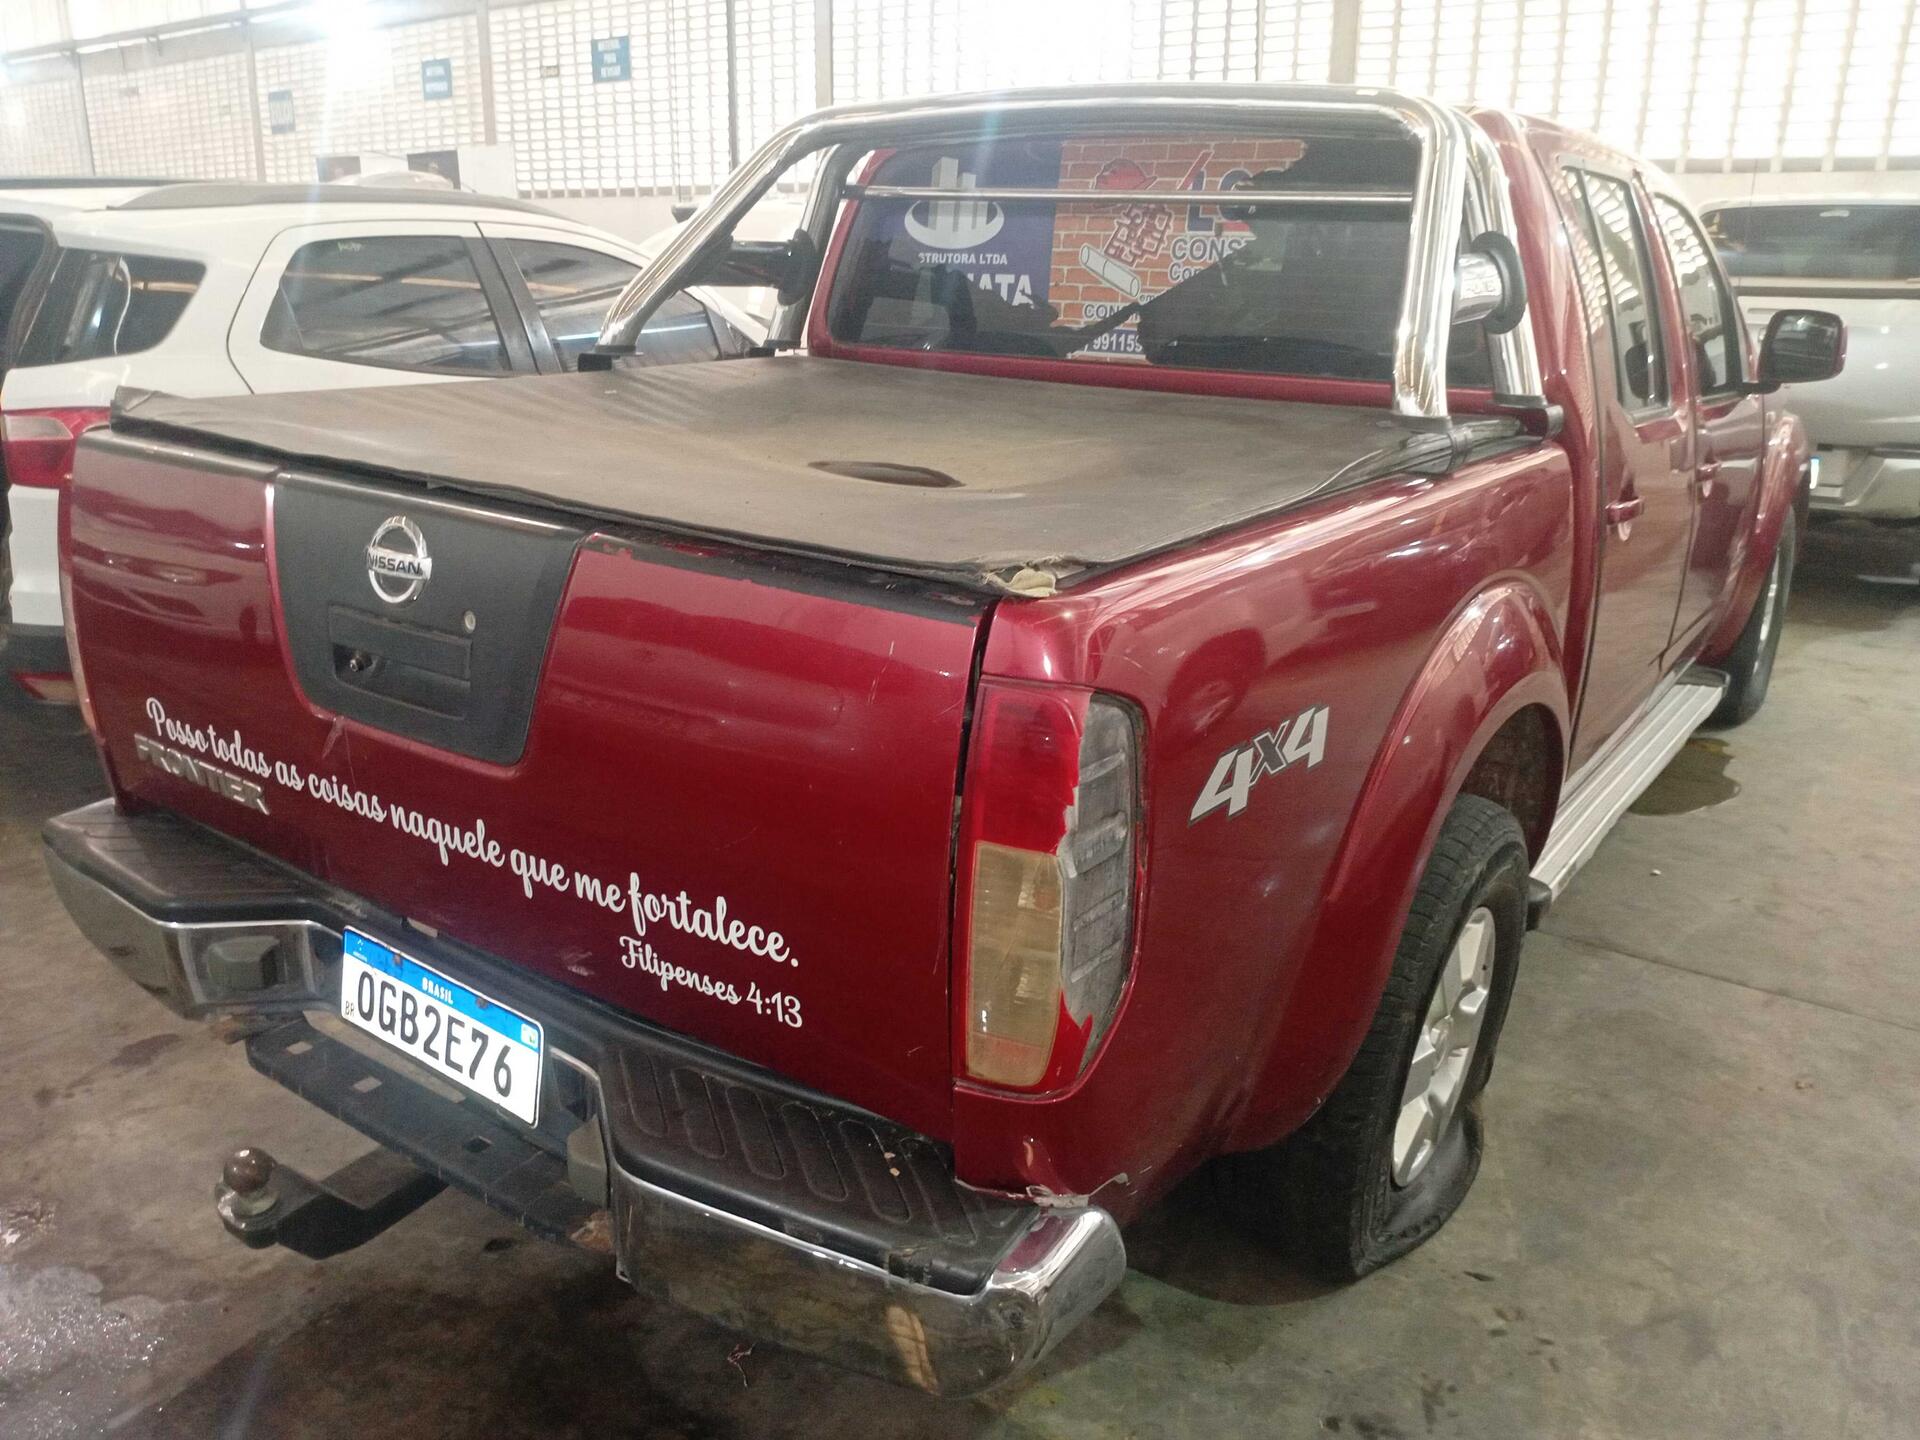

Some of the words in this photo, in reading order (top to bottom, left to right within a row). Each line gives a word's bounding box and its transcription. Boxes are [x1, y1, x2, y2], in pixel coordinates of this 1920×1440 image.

[979, 253, 1008, 265] LTDA
[367, 554, 421, 576] NISSAN
[134, 733, 270, 816] FRONTIER
[145, 697, 209, 753] Posso
[207, 724, 272, 778] todas
[275, 760, 304, 791] as
[308, 773, 388, 823] coisas
[390, 803, 506, 867] naquele
[510, 848, 570, 899] que
[575, 871, 627, 913] me
[625, 871, 800, 968] fortalece.
[421, 976, 454, 1005] BRASIL
[620, 935, 742, 1006] Filipenses
[745, 981, 803, 1029] 4:13
